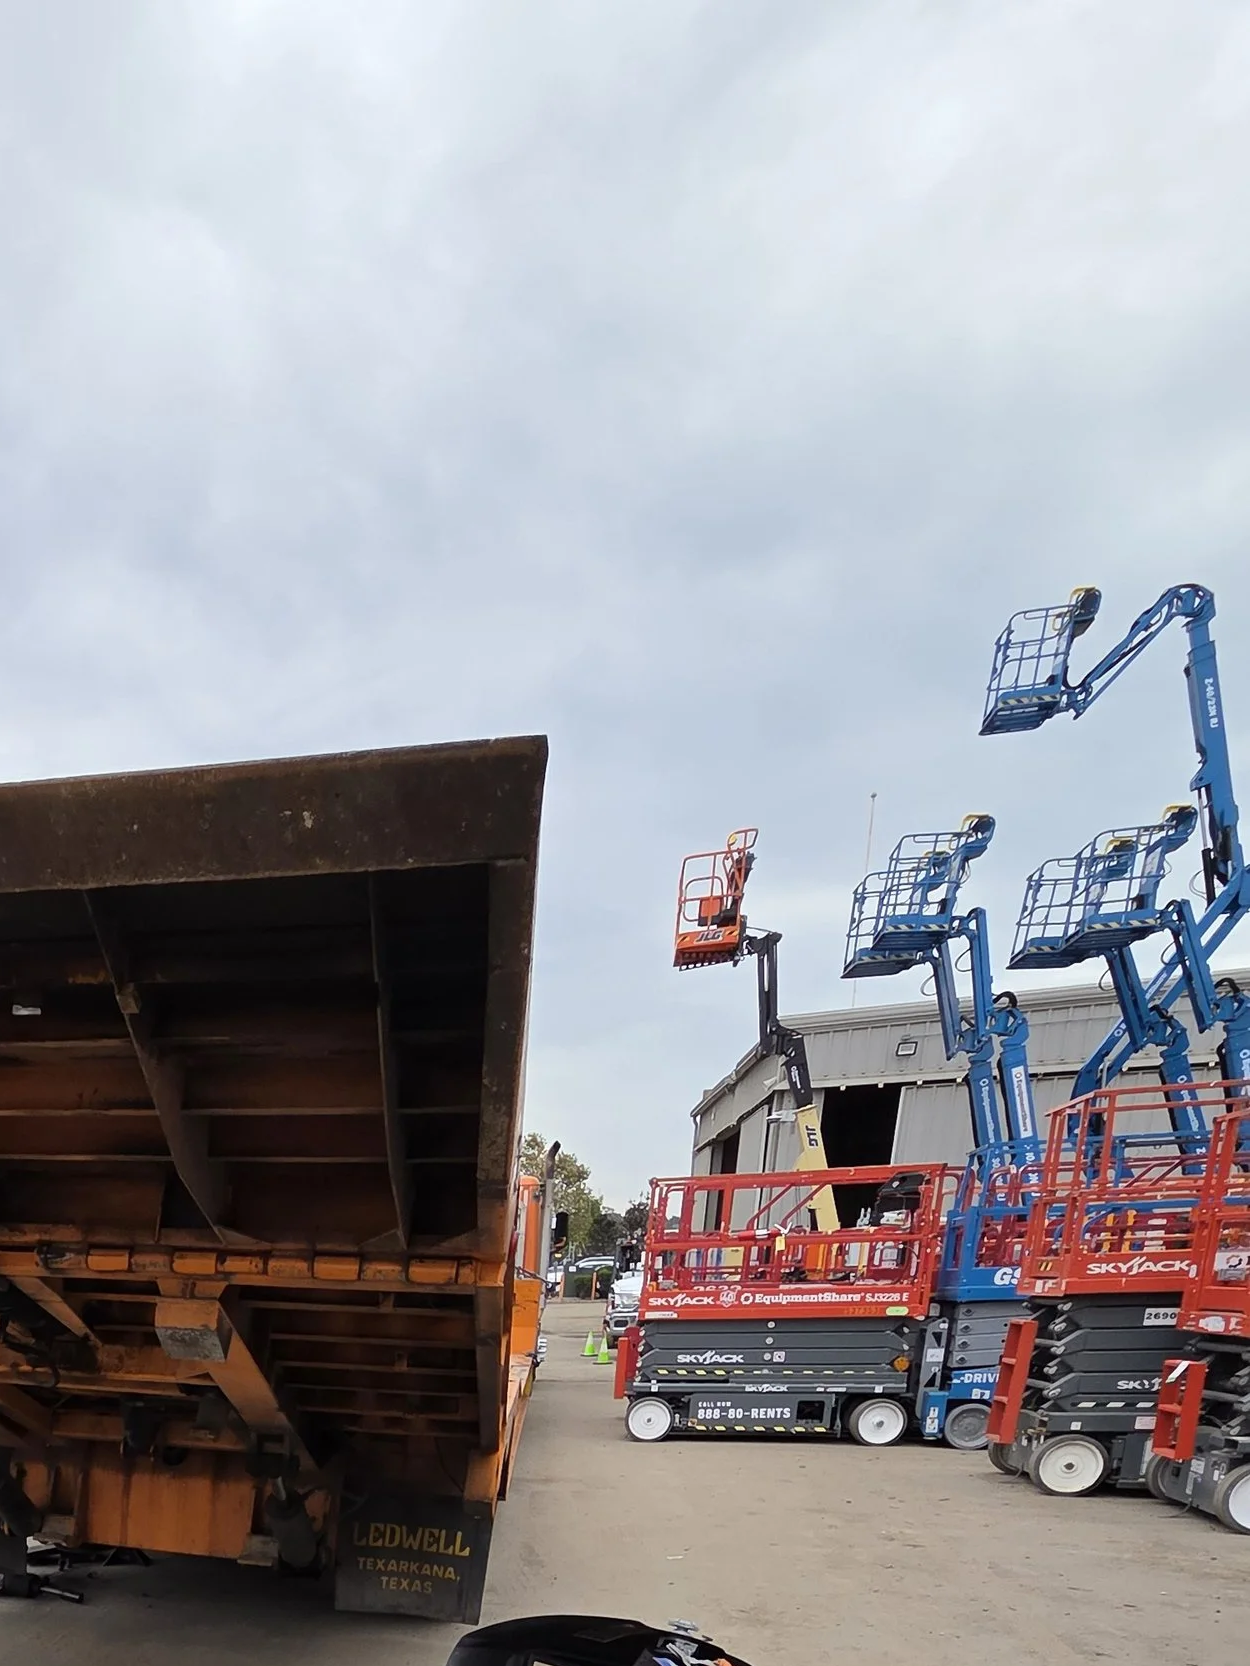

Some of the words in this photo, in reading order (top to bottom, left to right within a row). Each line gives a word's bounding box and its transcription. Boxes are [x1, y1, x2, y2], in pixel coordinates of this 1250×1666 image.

[805, 1125, 818, 1147] JLG
[1086, 1256, 1191, 1276] SKYJACK
[648, 1293, 715, 1307] SKYJACK
[677, 1350, 744, 1364] SKYJACK
[697, 1408, 791, 1419] 888-80-RENTS
[353, 1522, 471, 1557] LEDWELL
[357, 1557, 461, 1581] TEXARKANA,
[380, 1576, 433, 1594] TEXAS
